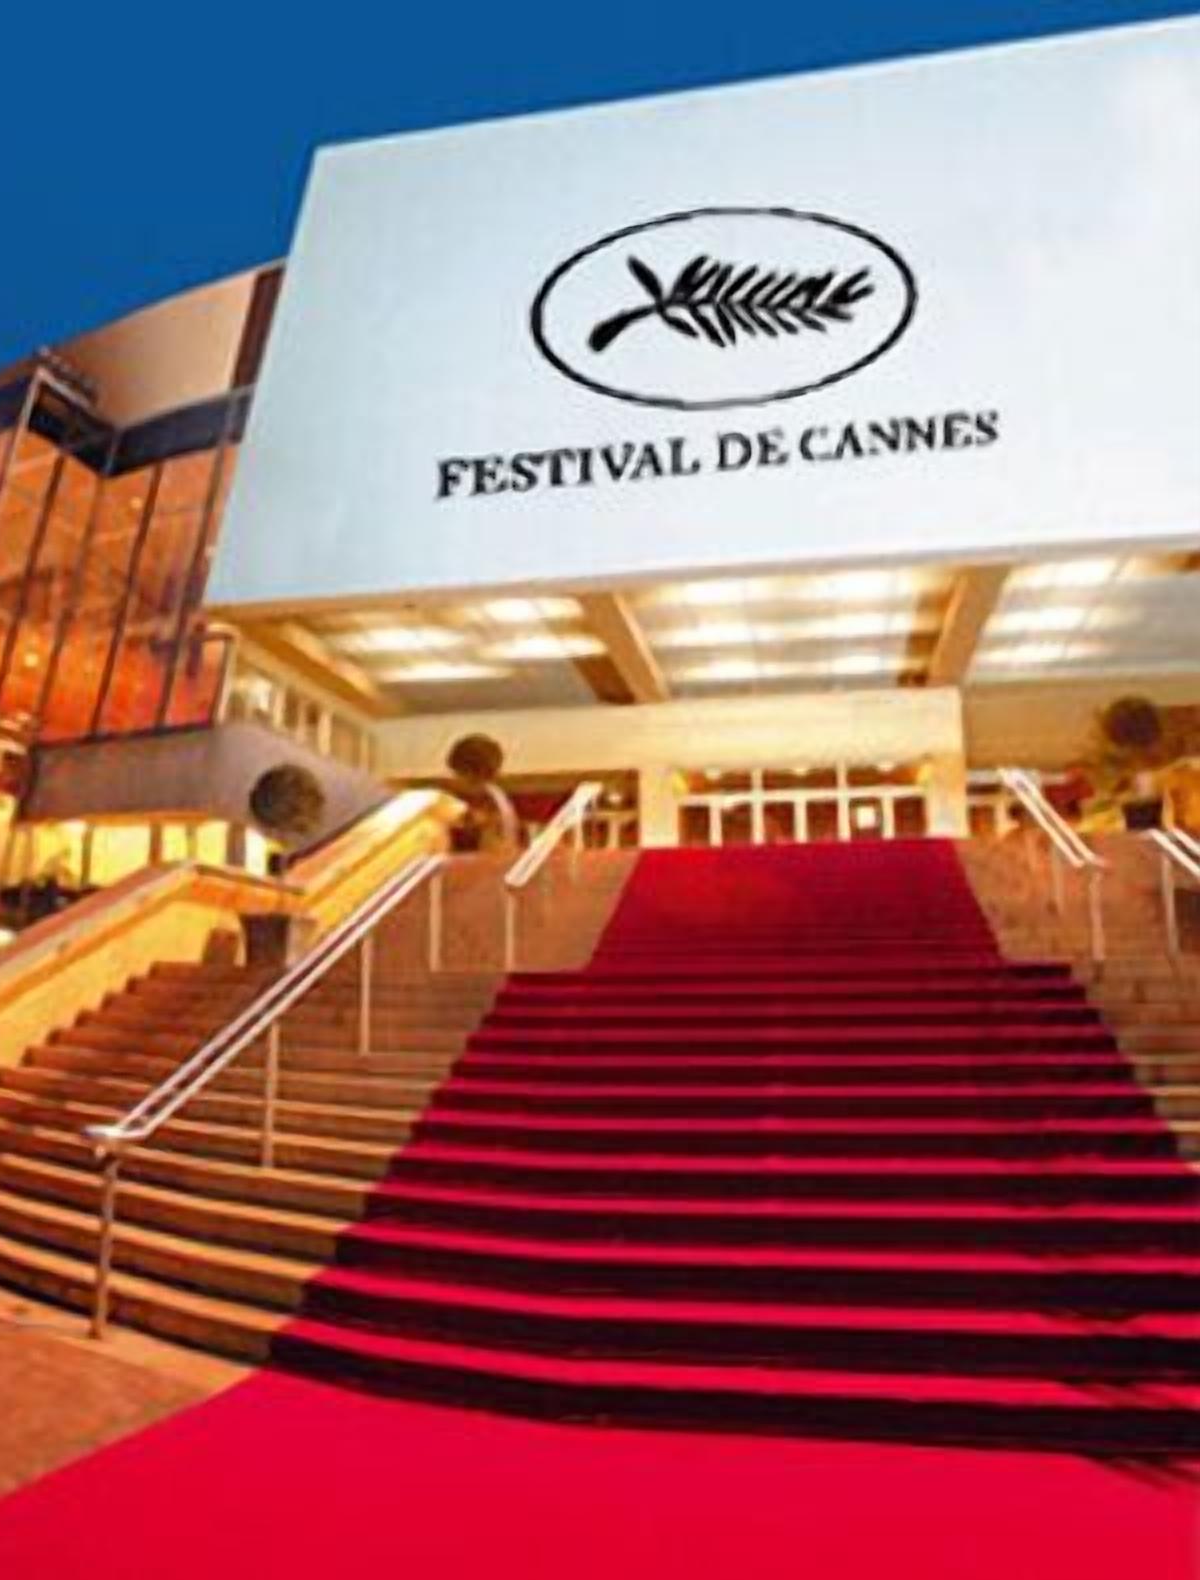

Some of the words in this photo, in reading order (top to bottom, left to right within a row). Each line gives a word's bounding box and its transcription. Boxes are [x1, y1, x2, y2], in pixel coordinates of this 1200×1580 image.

[436, 437, 701, 499] FESTIVAL
[717, 430, 788, 471] DE
[800, 410, 999, 461] CANNES
